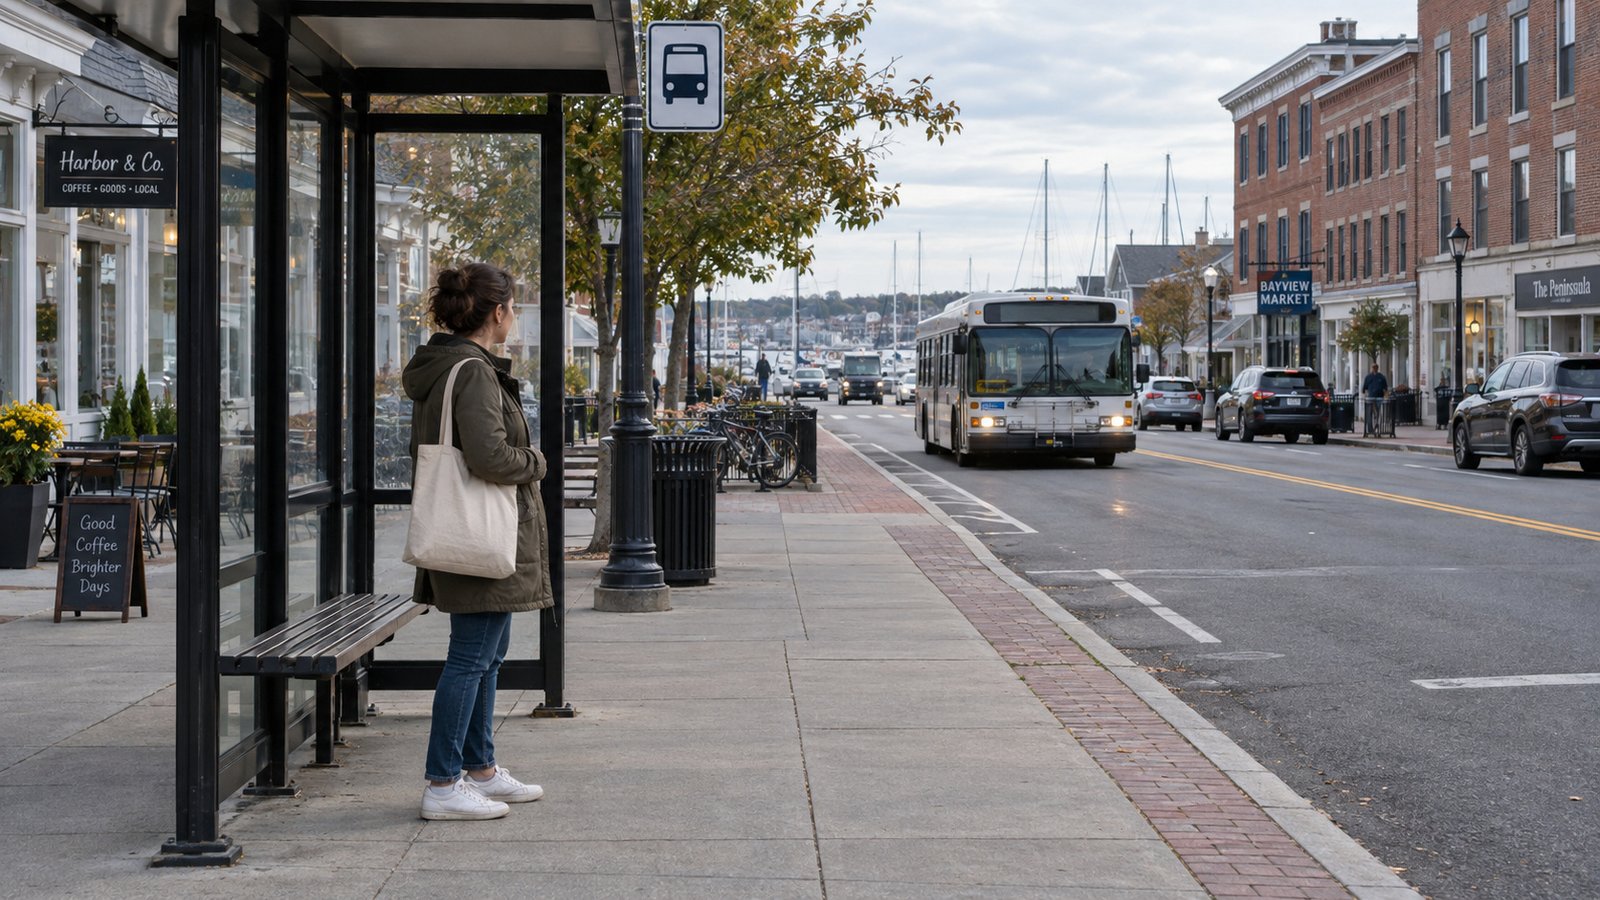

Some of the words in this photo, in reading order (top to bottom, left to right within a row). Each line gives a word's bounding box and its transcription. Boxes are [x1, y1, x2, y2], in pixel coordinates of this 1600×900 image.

[59, 150, 119, 172] Harbor
[123, 154, 136, 172] &
[141, 151, 164, 172] Co.
[62, 183, 92, 193] COFFEE
[100, 184, 126, 193] GOODS
[134, 184, 159, 194] LOCAL
[1260, 281, 1310, 292] BAYVIEW
[1533, 280, 1548, 298] The
[1260, 293, 1310, 305] MARKET
[80, 514, 116, 530] Good
[75, 536, 118, 555] Coffee
[71, 558, 122, 578] Brighter
[80, 578, 110, 598] Days
